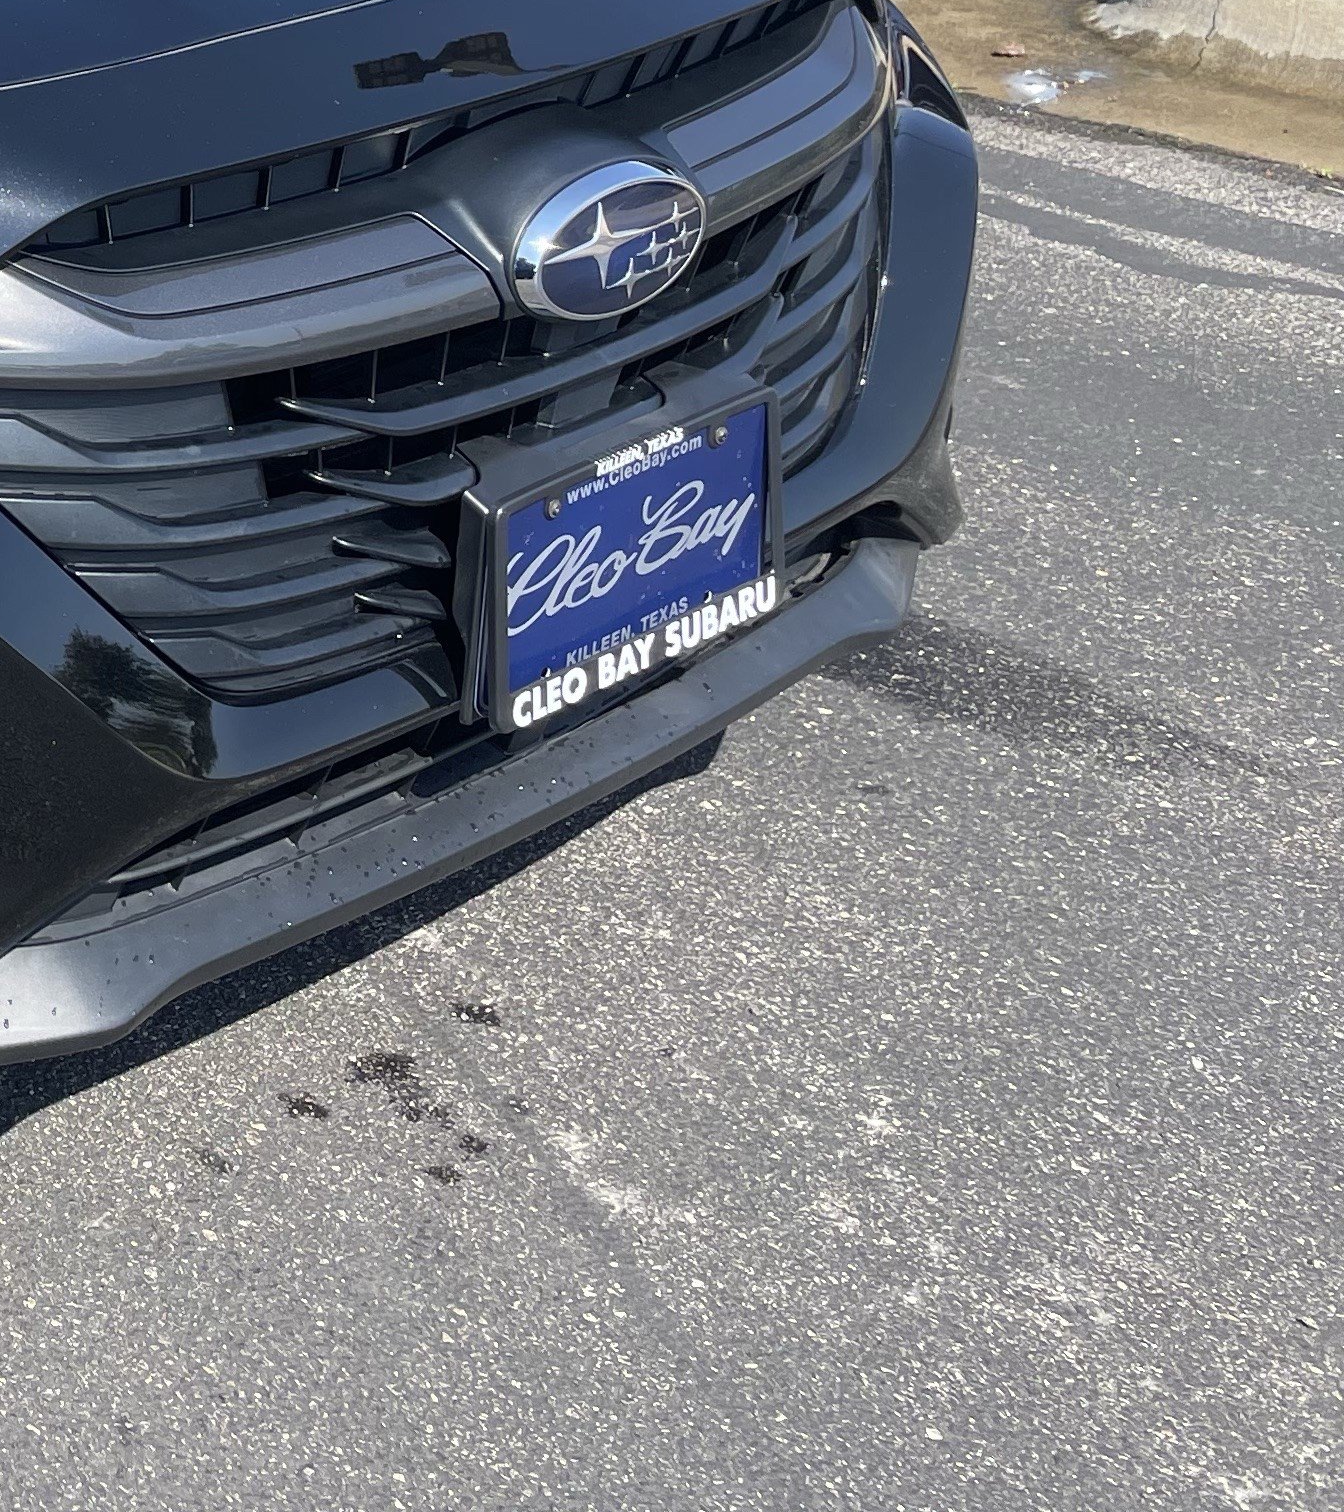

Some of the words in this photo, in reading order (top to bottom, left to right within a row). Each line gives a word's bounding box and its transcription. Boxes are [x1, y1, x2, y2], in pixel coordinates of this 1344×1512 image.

[566, 435, 703, 505] www.CleoBay.com
[507, 525, 637, 637] Cleo
[635, 480, 756, 576] Bay
[640, 596, 689, 632] TEXAS
[512, 667, 588, 729] CLEO
[598, 633, 655, 690] BAY
[664, 574, 776, 658] SUBARU
